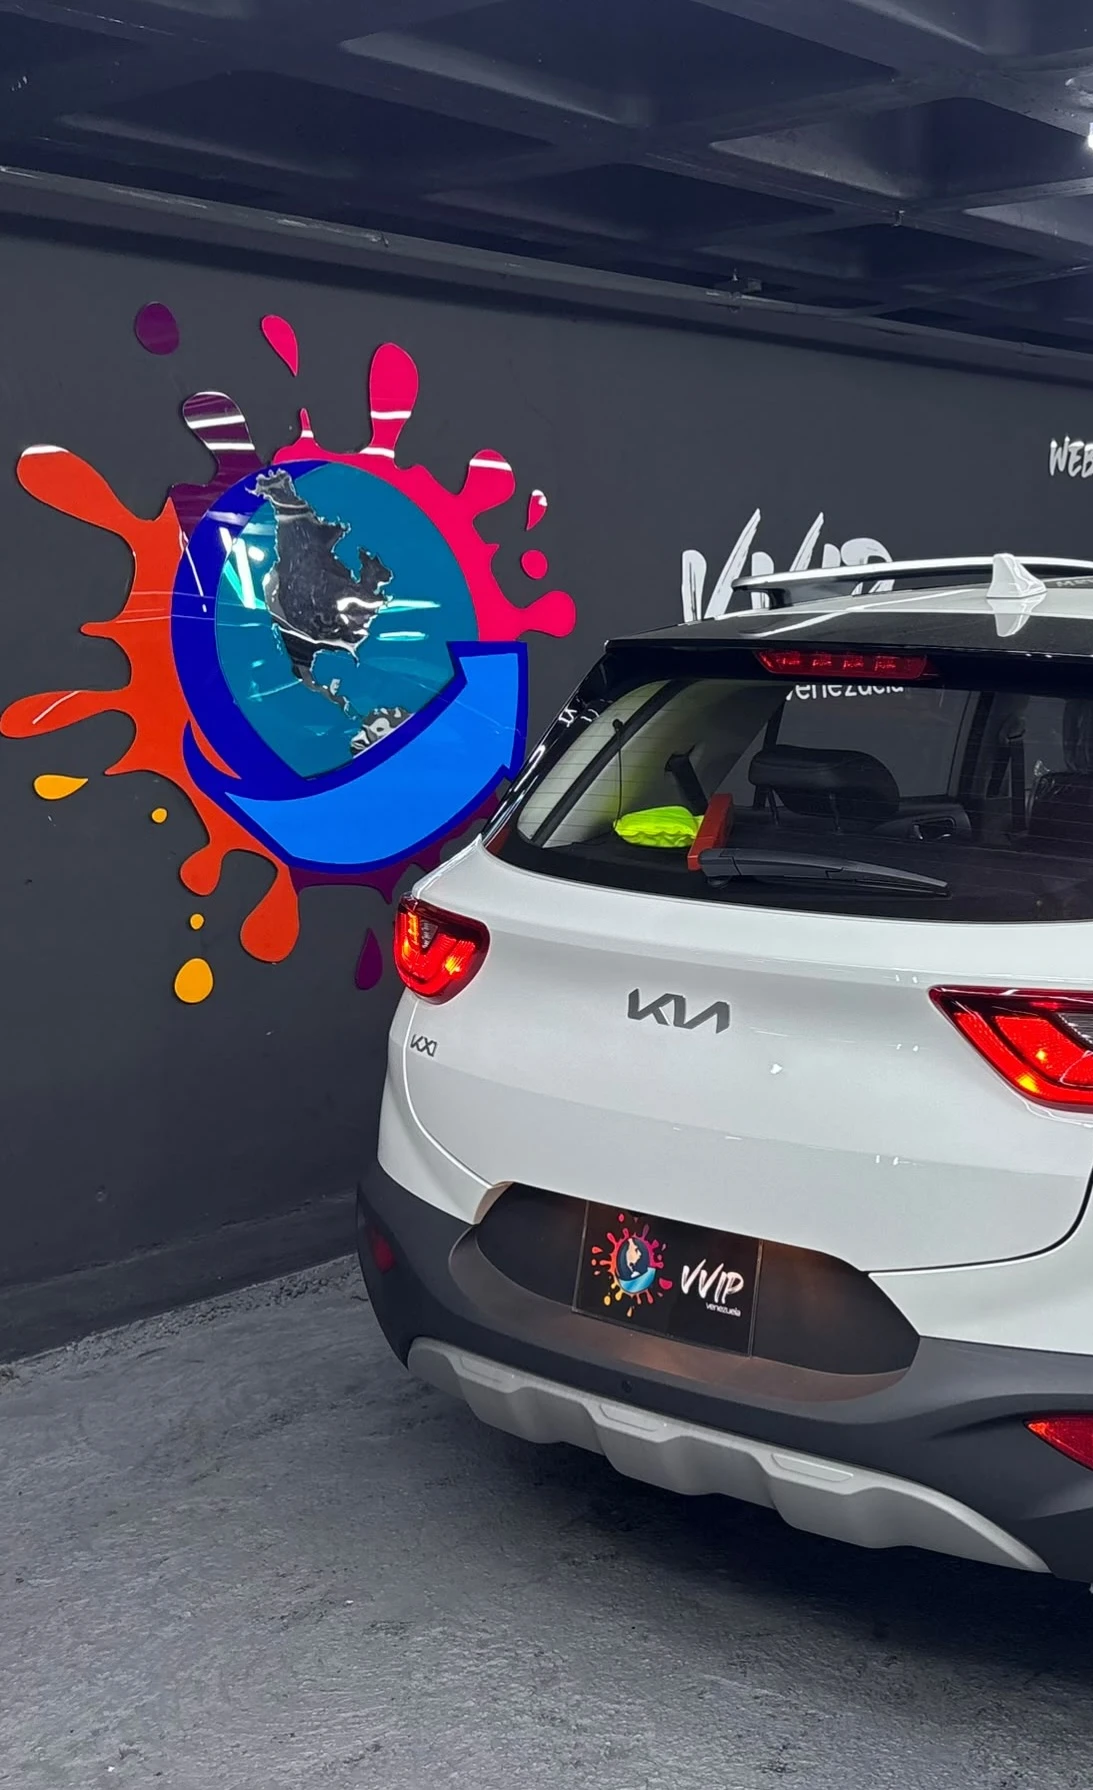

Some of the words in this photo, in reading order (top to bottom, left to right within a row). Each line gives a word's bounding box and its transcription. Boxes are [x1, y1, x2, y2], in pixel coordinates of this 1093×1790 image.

[627, 987, 731, 1035] KIA
[681, 1258, 745, 1305] VVIP
[705, 1301, 742, 1318] venezuela
